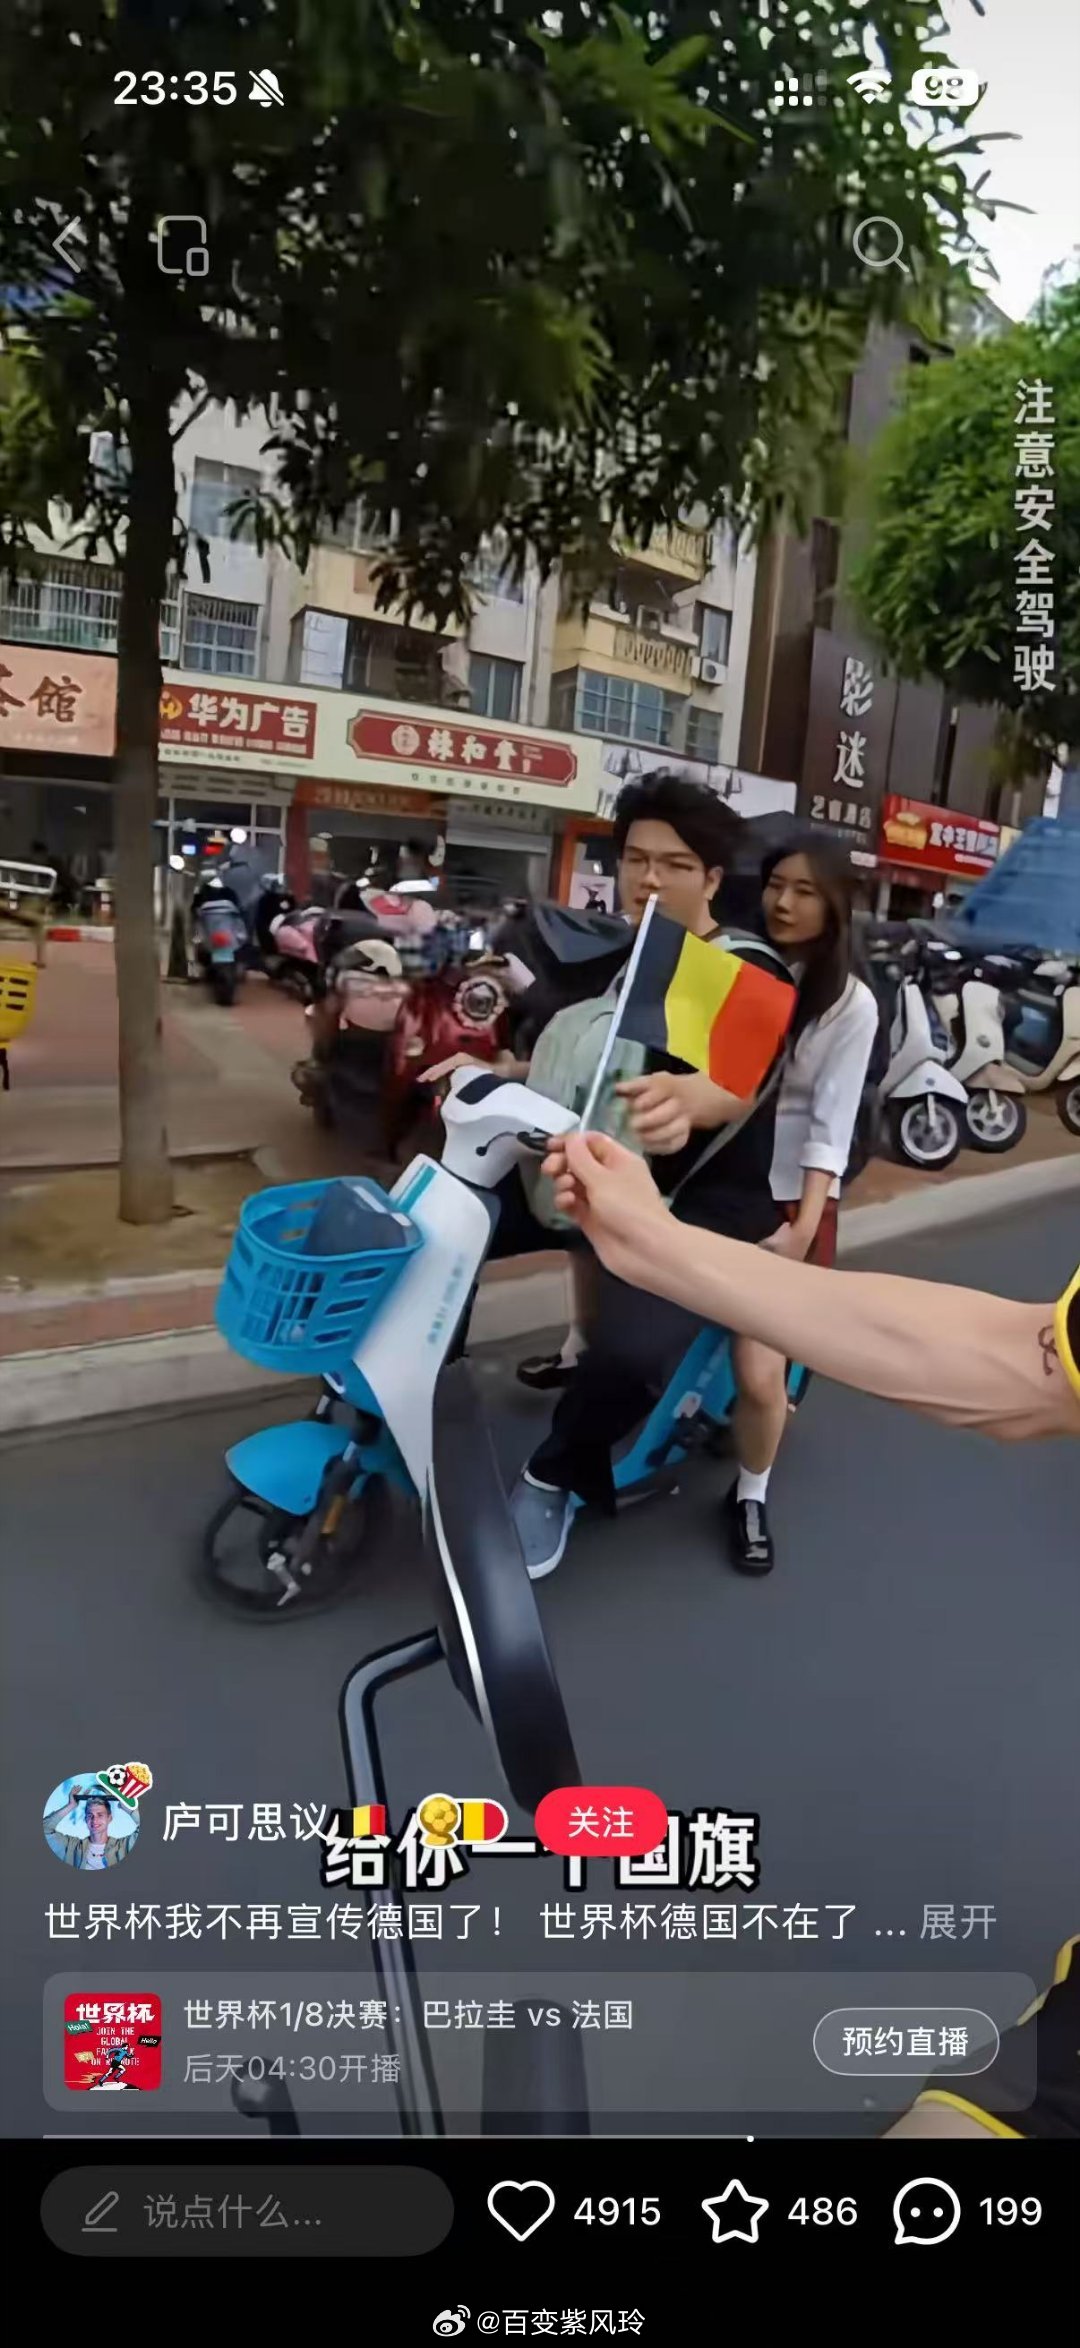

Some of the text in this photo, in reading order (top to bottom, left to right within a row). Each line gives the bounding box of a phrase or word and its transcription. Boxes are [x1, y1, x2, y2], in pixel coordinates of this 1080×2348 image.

[187, 692, 310, 739] 华为广告
[833, 656, 874, 789] 影迷
